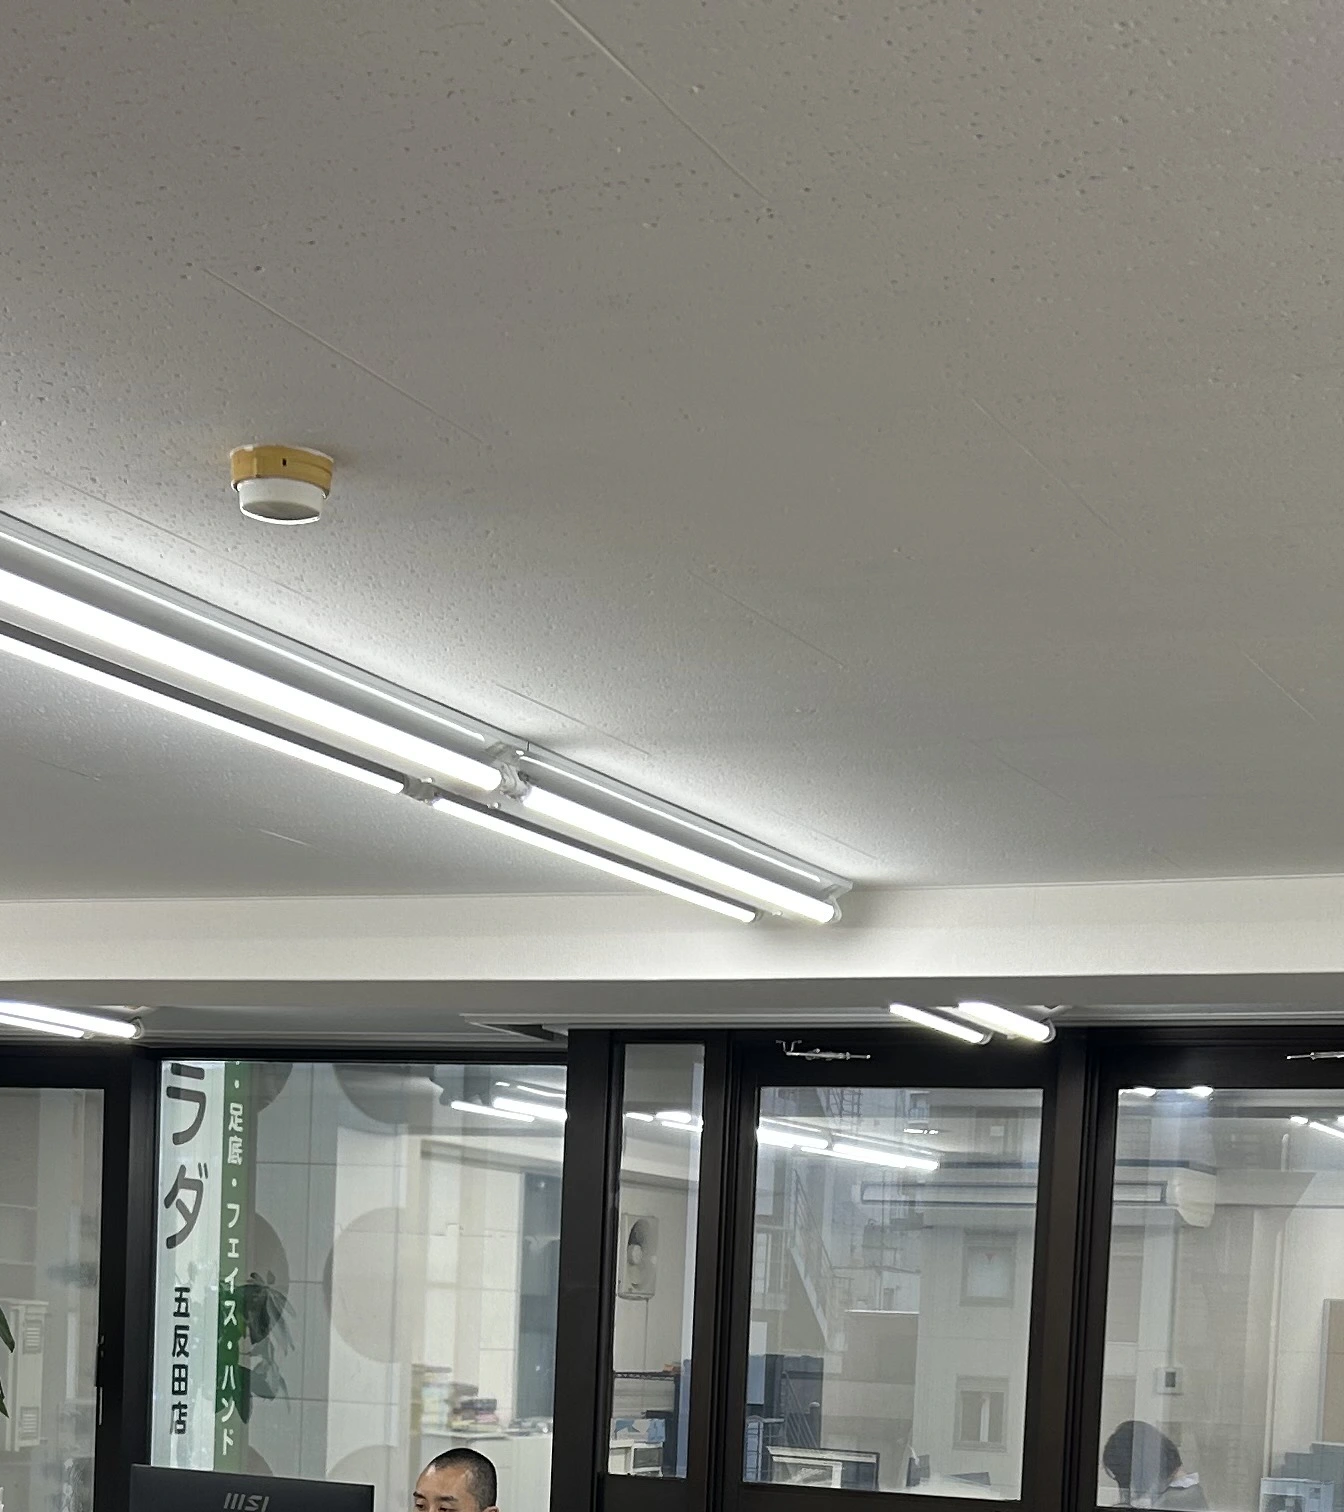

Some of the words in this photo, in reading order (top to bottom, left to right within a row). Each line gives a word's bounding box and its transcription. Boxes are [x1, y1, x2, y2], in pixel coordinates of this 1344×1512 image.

[169, 1286, 192, 1436] 五反田店
[216, 1060, 245, 1457] ・足底・フェイス・ハンド
